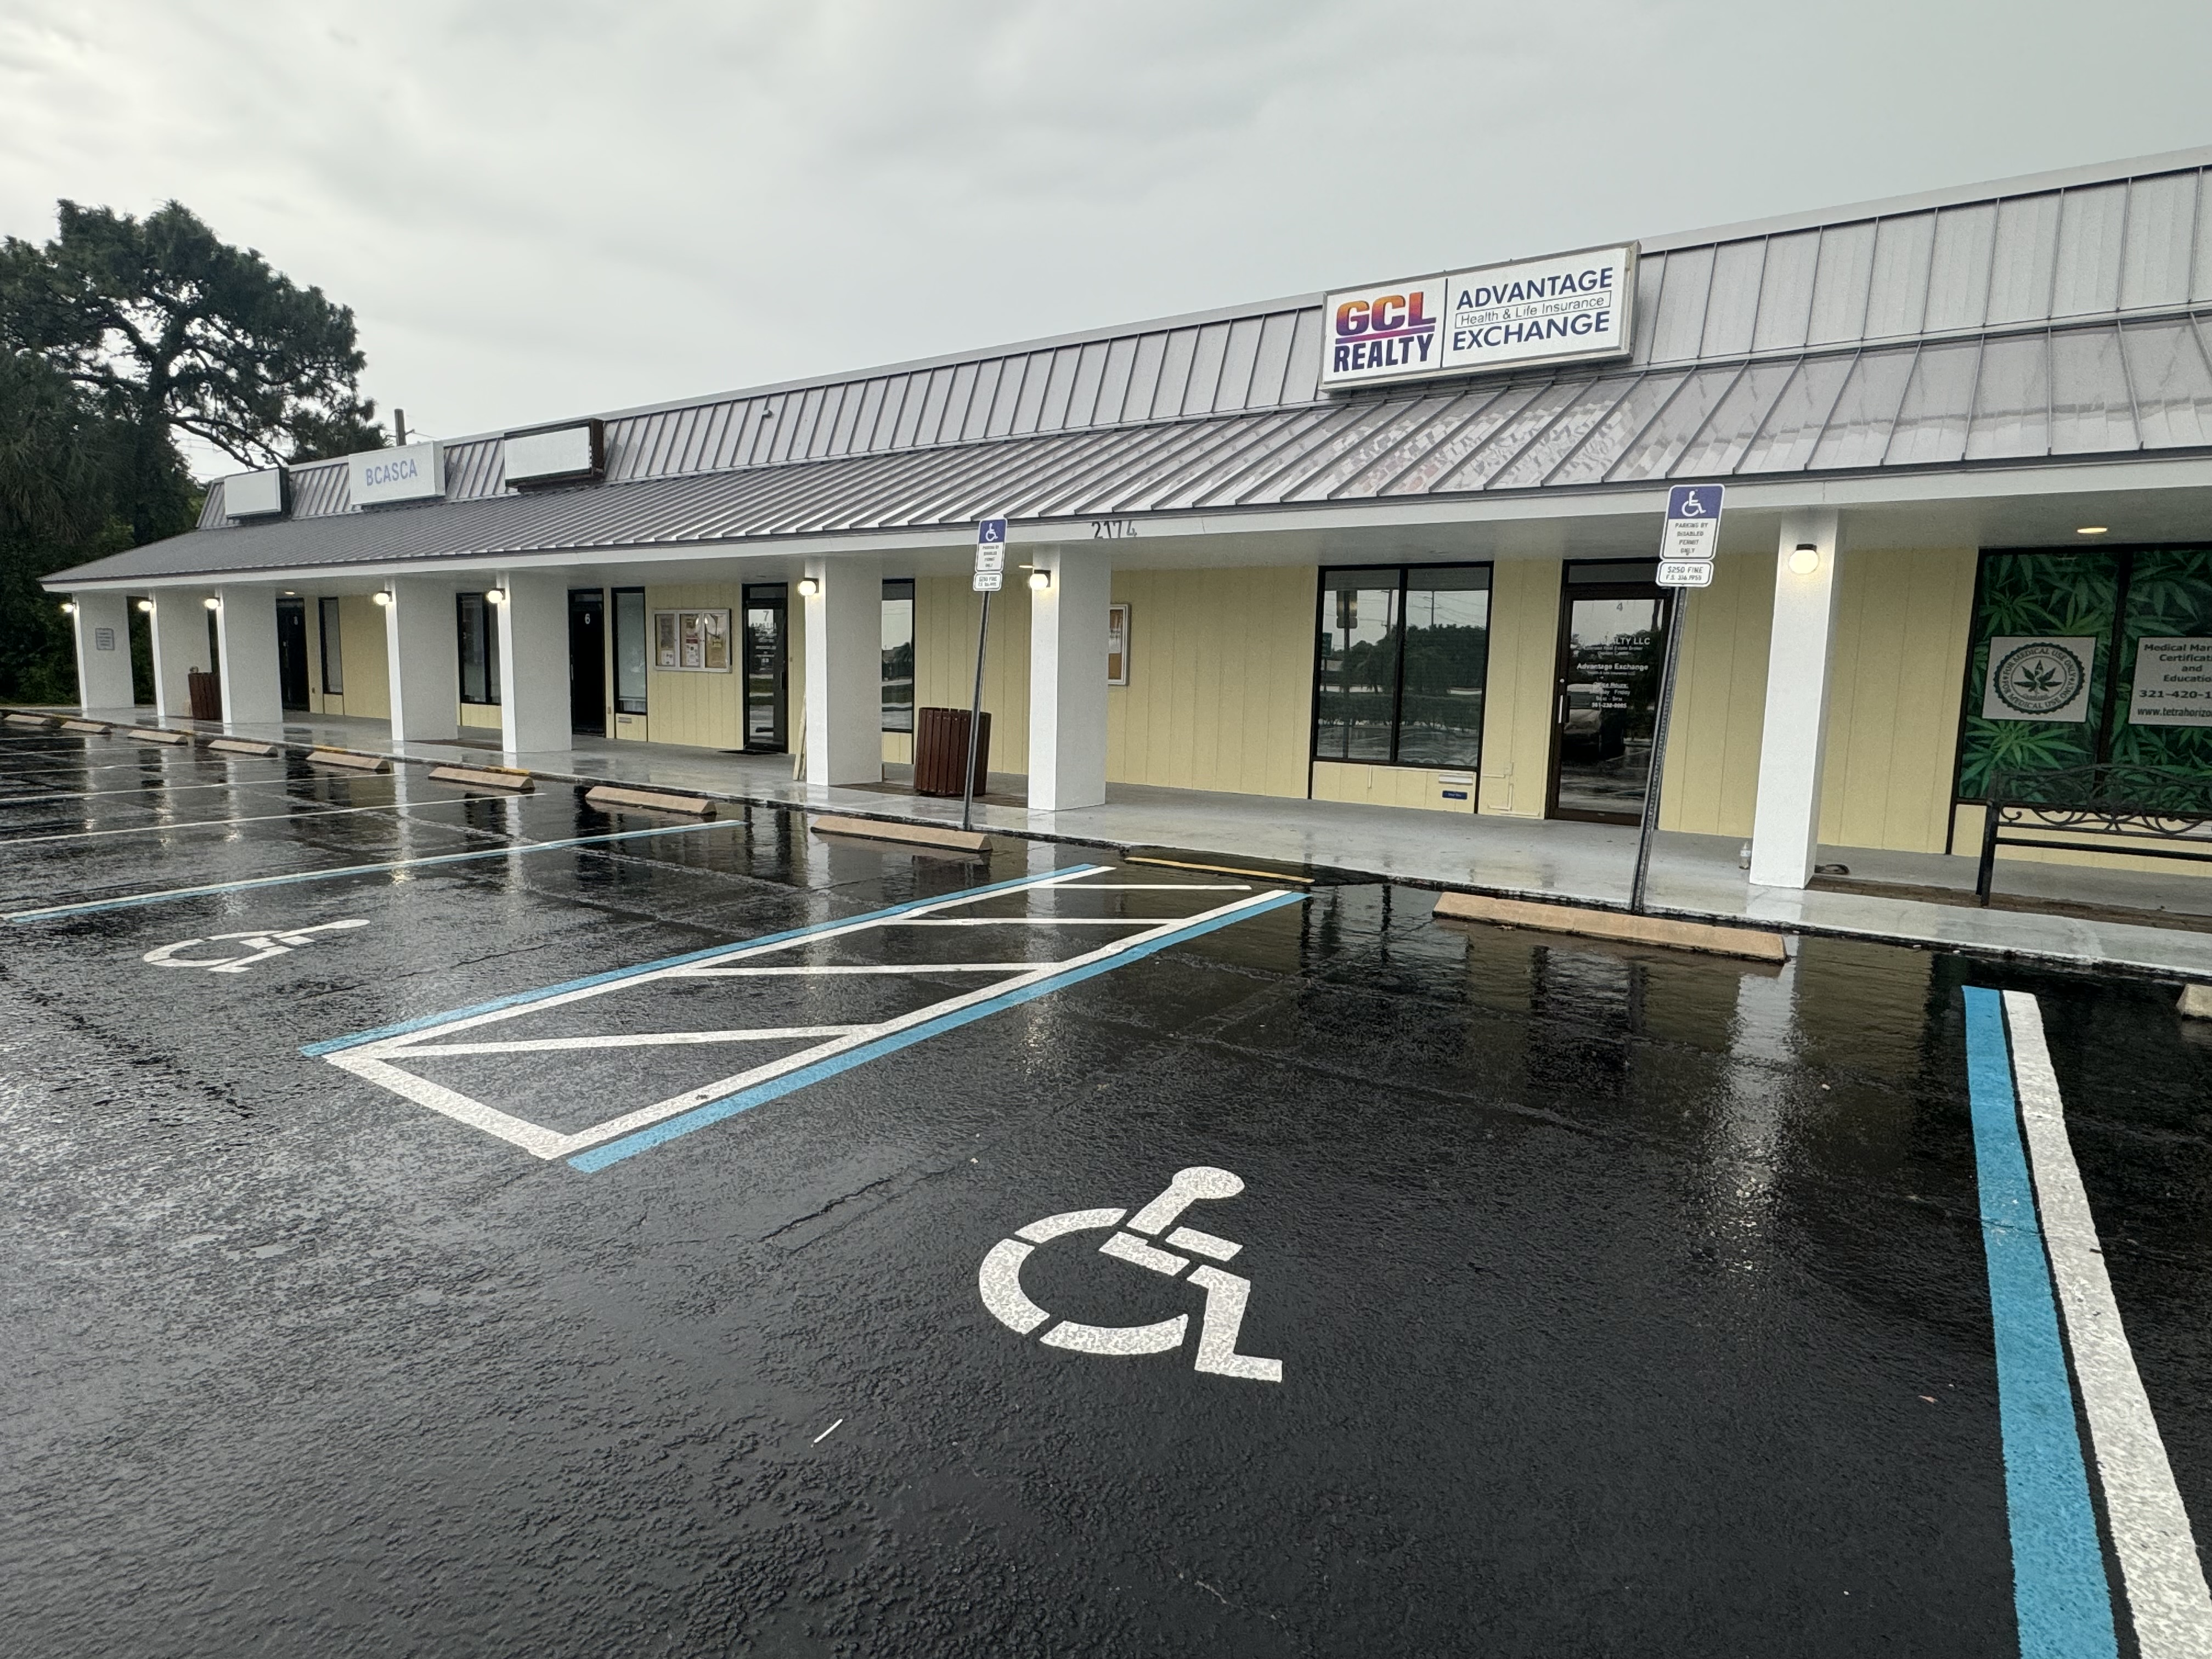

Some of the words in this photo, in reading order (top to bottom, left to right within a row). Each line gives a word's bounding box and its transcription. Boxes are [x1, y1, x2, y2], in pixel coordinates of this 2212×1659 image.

[1456, 267, 1613, 310] ADVANTAGE
[1335, 291, 1436, 337] GCL
[1460, 311, 1499, 325] Health
[1503, 309, 1511, 320] &
[1516, 306, 1537, 318] Life
[1542, 296, 1604, 314] Insurance
[1453, 311, 1610, 351] EXCHANGE
[1334, 334, 1434, 373] REALTY
[365, 459, 418, 486] BCASCA
[1091, 520, 1137, 539] 2174
[763, 610, 769, 622] 7
[1616, 602, 1623, 611] 4
[1634, 636, 1650, 645] LLC
[1577, 663, 1612, 671] Advantage
[1614, 663, 1648, 672] Exchange
[2005, 661, 2016, 675] FOR
[2014, 648, 2050, 662] MEDICAL
[2051, 650, 2067, 662] USE
[2064, 660, 2076, 678] ONLY
[2007, 693, 2043, 709] MEDICAL
[2045, 698, 2062, 707] USE
[2059, 680, 2074, 699] ONLY
[2138, 690, 2212, 699] 321-420-1
